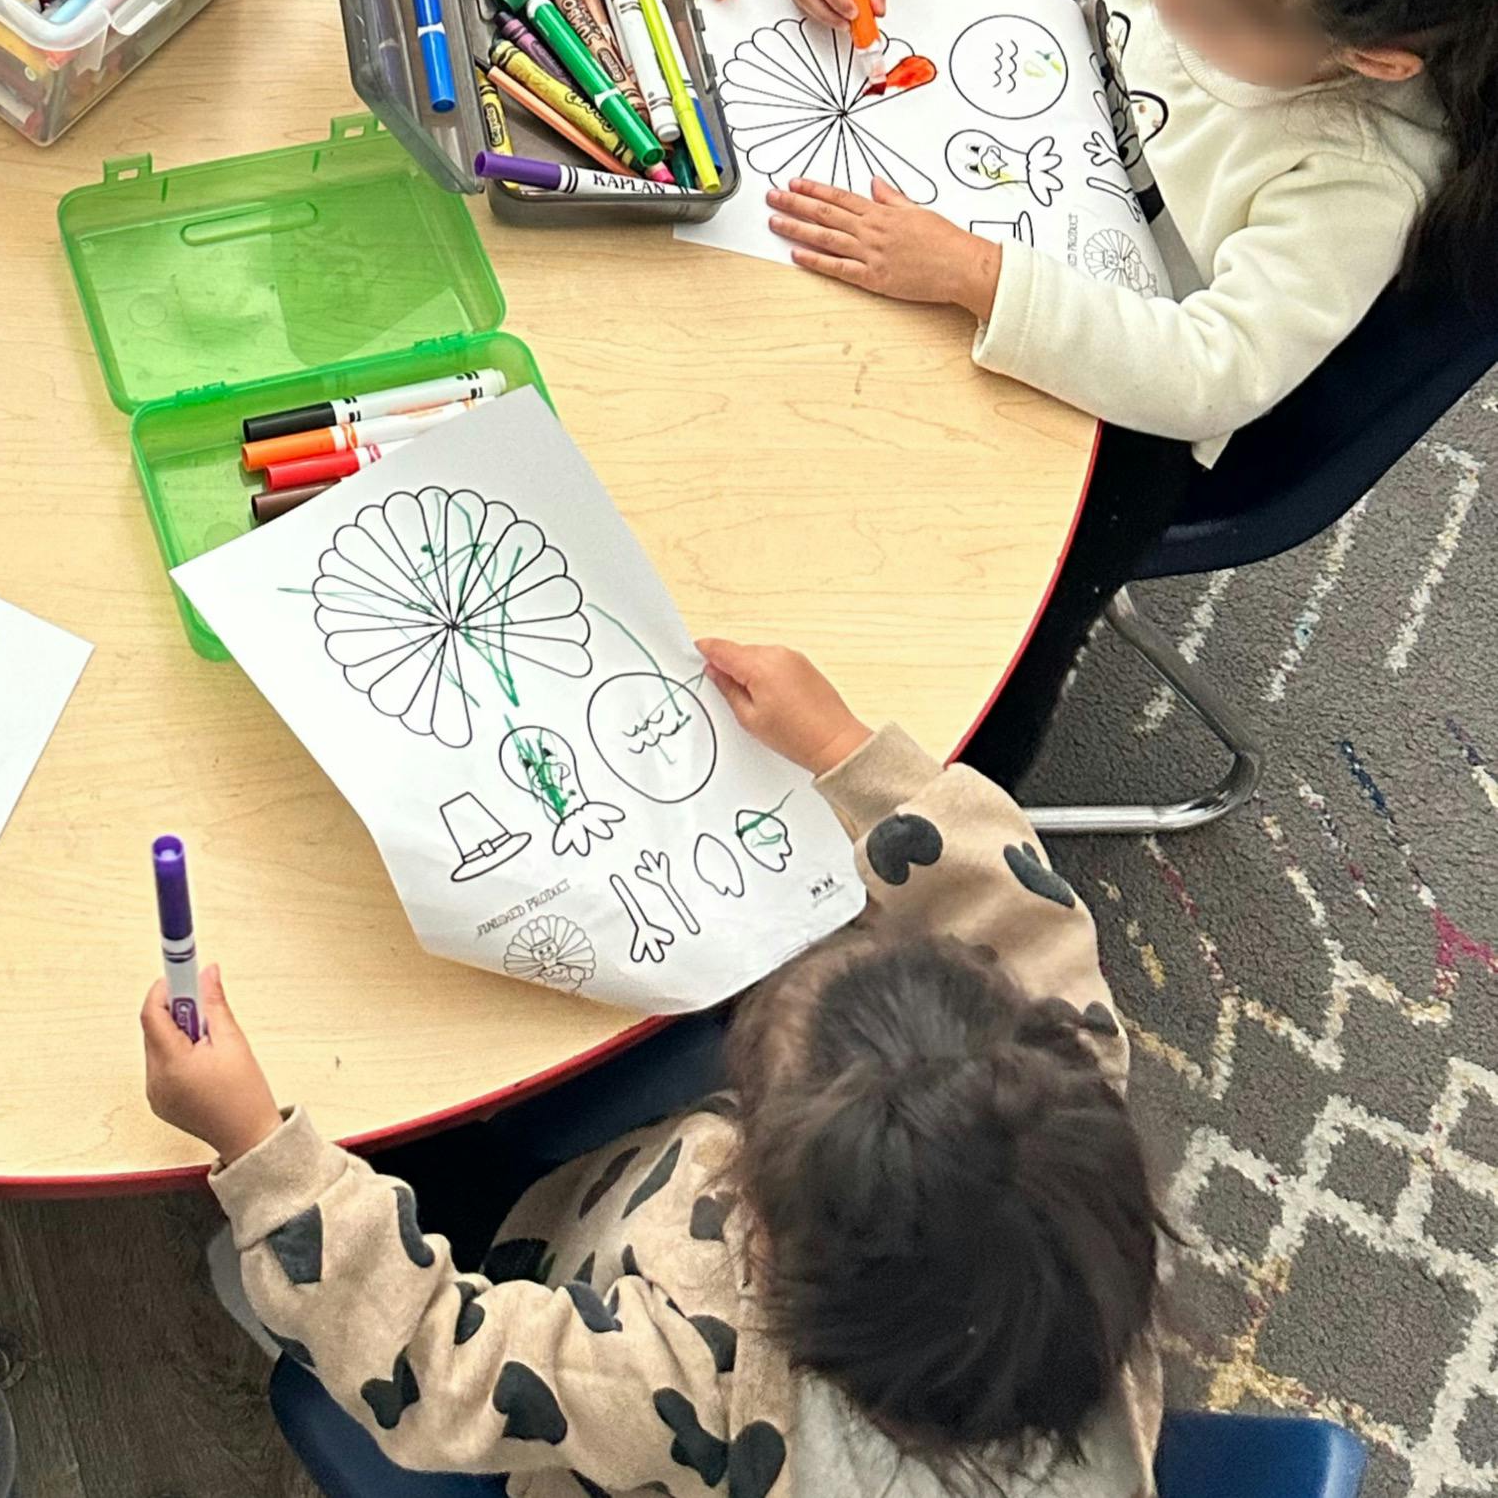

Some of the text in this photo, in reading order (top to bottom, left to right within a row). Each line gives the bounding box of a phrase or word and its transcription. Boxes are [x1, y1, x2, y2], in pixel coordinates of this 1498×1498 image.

[593, 173, 666, 193] KAPLAN
[477, 878, 571, 938] FINISHED PRODUCT
